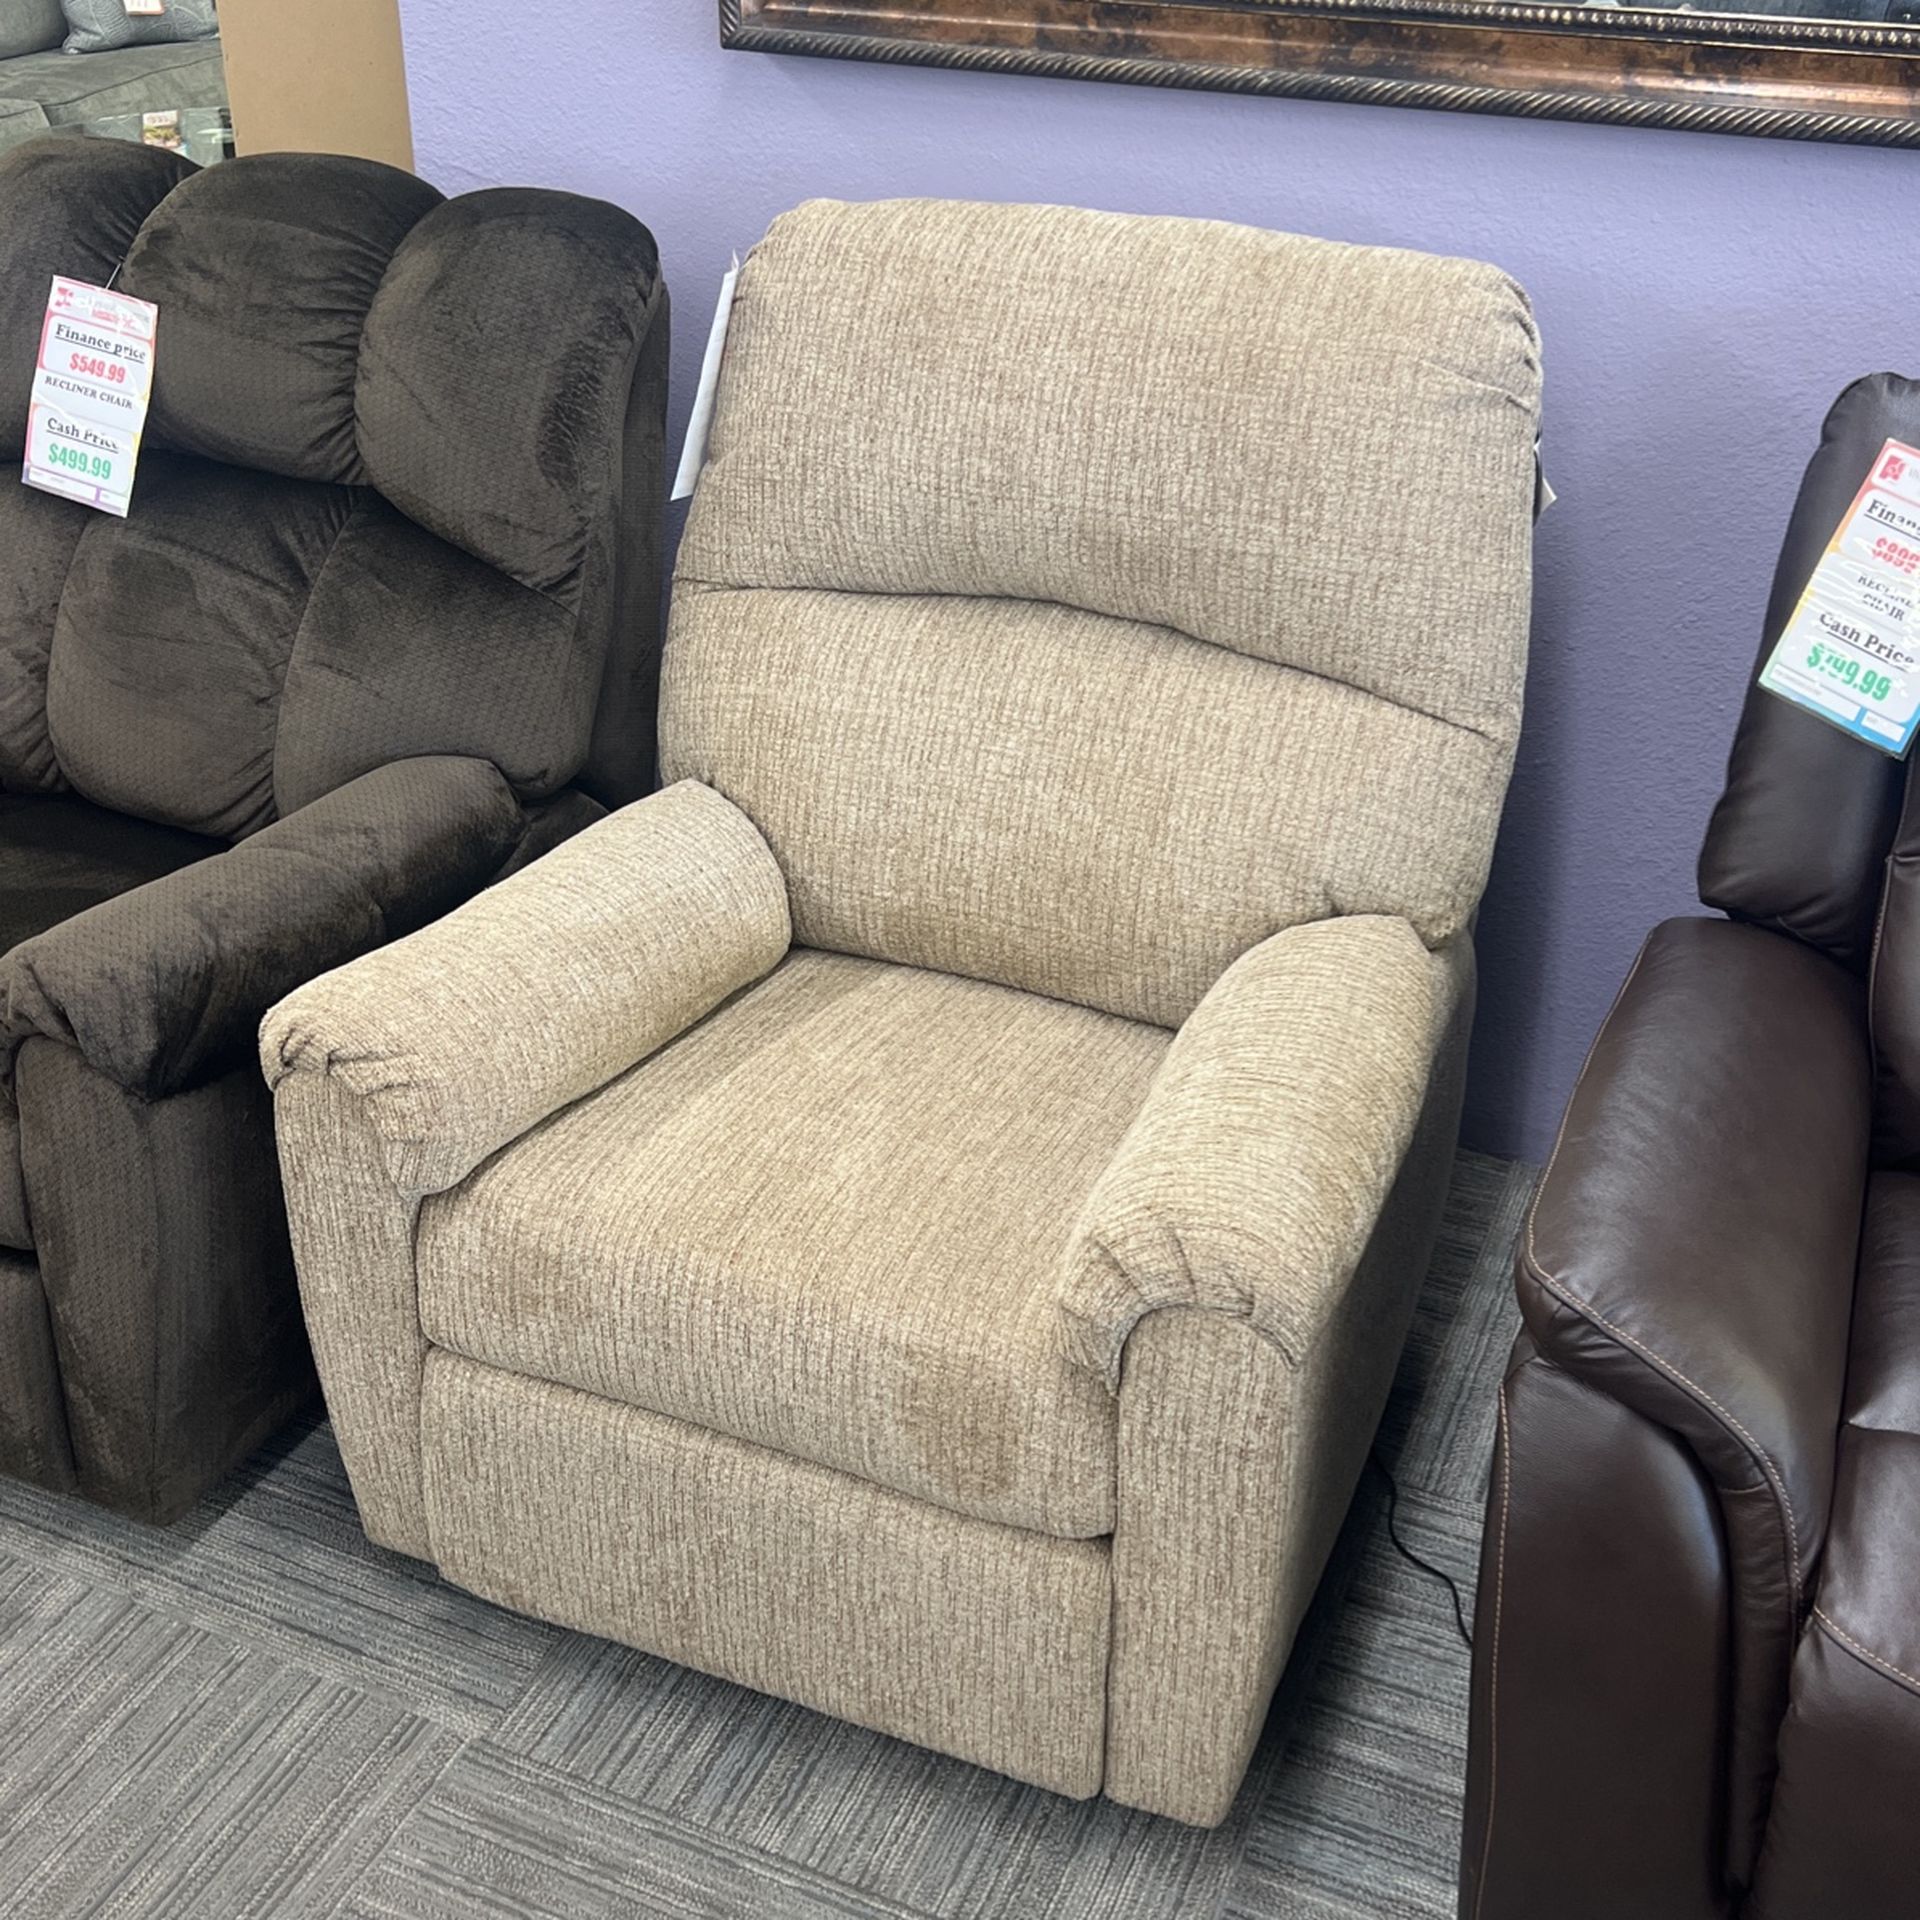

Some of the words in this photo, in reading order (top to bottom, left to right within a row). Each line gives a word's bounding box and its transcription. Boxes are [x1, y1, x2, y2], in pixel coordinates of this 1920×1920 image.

[56, 323, 111, 350] Finance
[69, 352, 126, 384] $549.99
[44, 375, 98, 400] RECLINER
[99, 391, 133, 409] CHAIR
[47, 417, 80, 438] Cash
[48, 442, 112, 480] $499.99
[1820, 611, 1861, 643] Cash
[1863, 634, 1915, 664] Price
